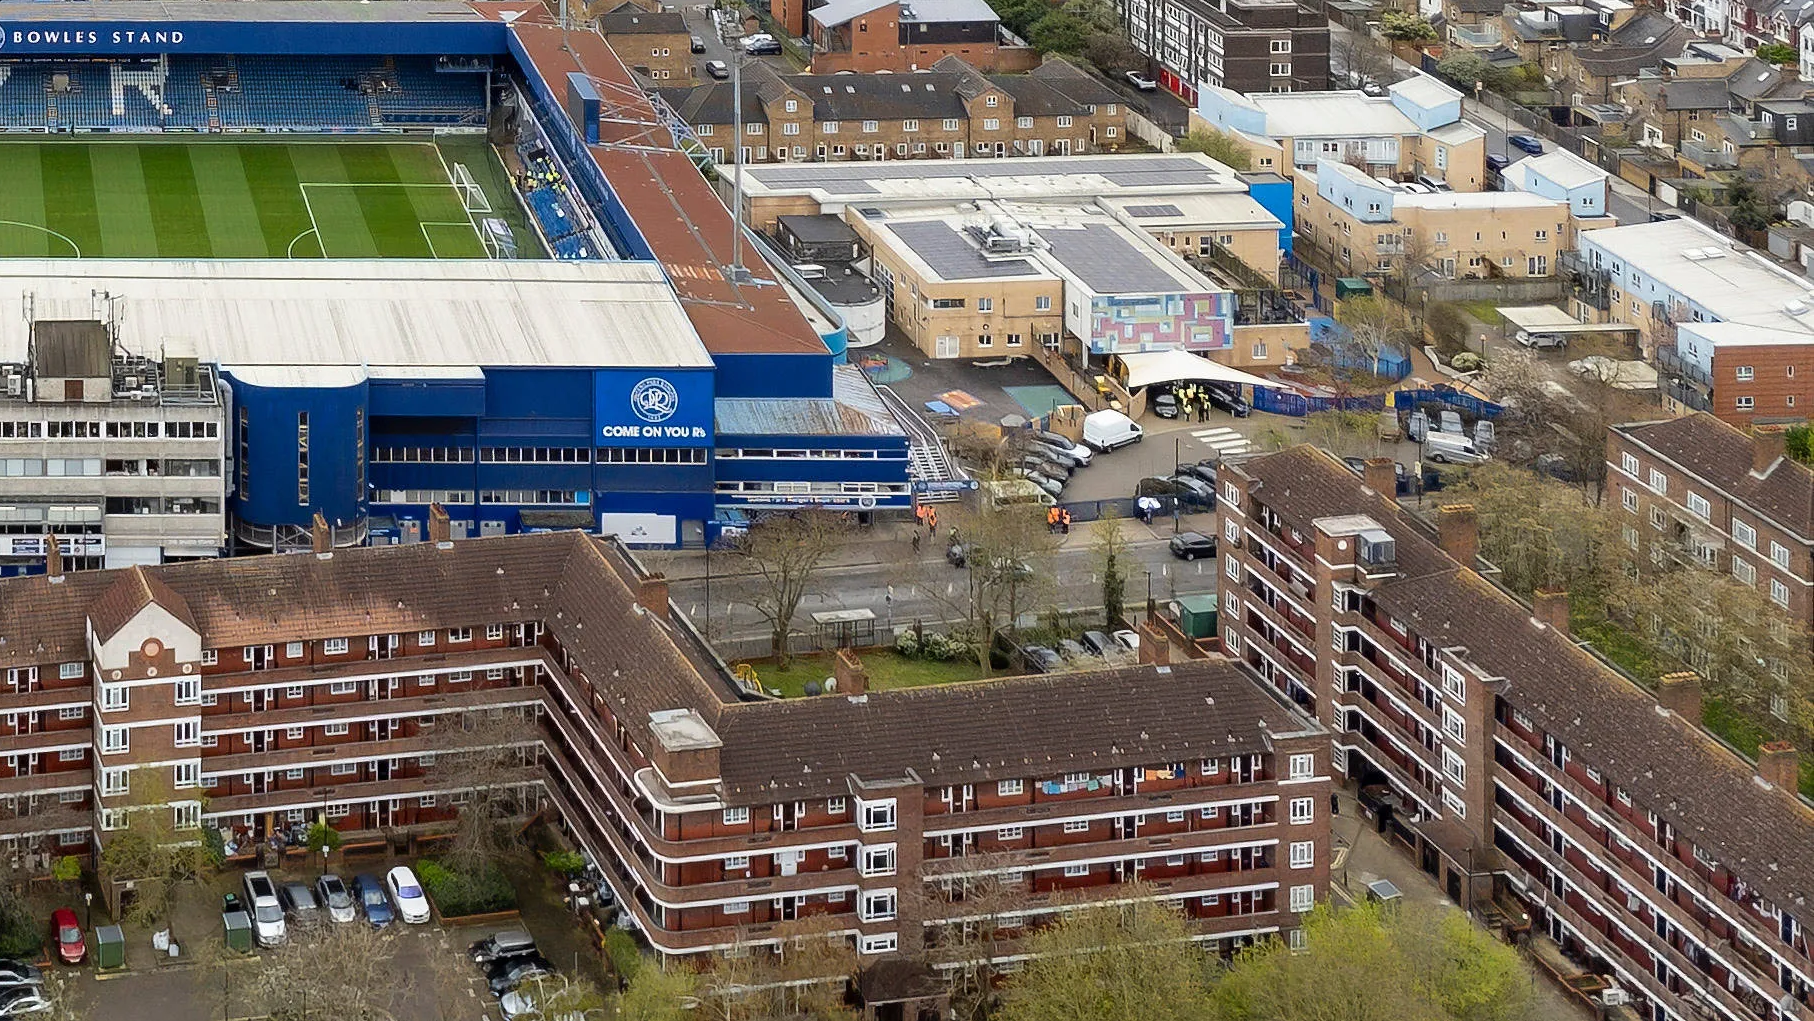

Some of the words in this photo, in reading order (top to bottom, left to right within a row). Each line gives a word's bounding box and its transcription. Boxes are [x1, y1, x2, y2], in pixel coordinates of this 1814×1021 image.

[13, 31, 97, 43] BOWLES
[112, 31, 184, 43] STAND
[602, 425, 640, 437] COME
[642, 426, 662, 437] ON
[663, 426, 690, 437] YOU
